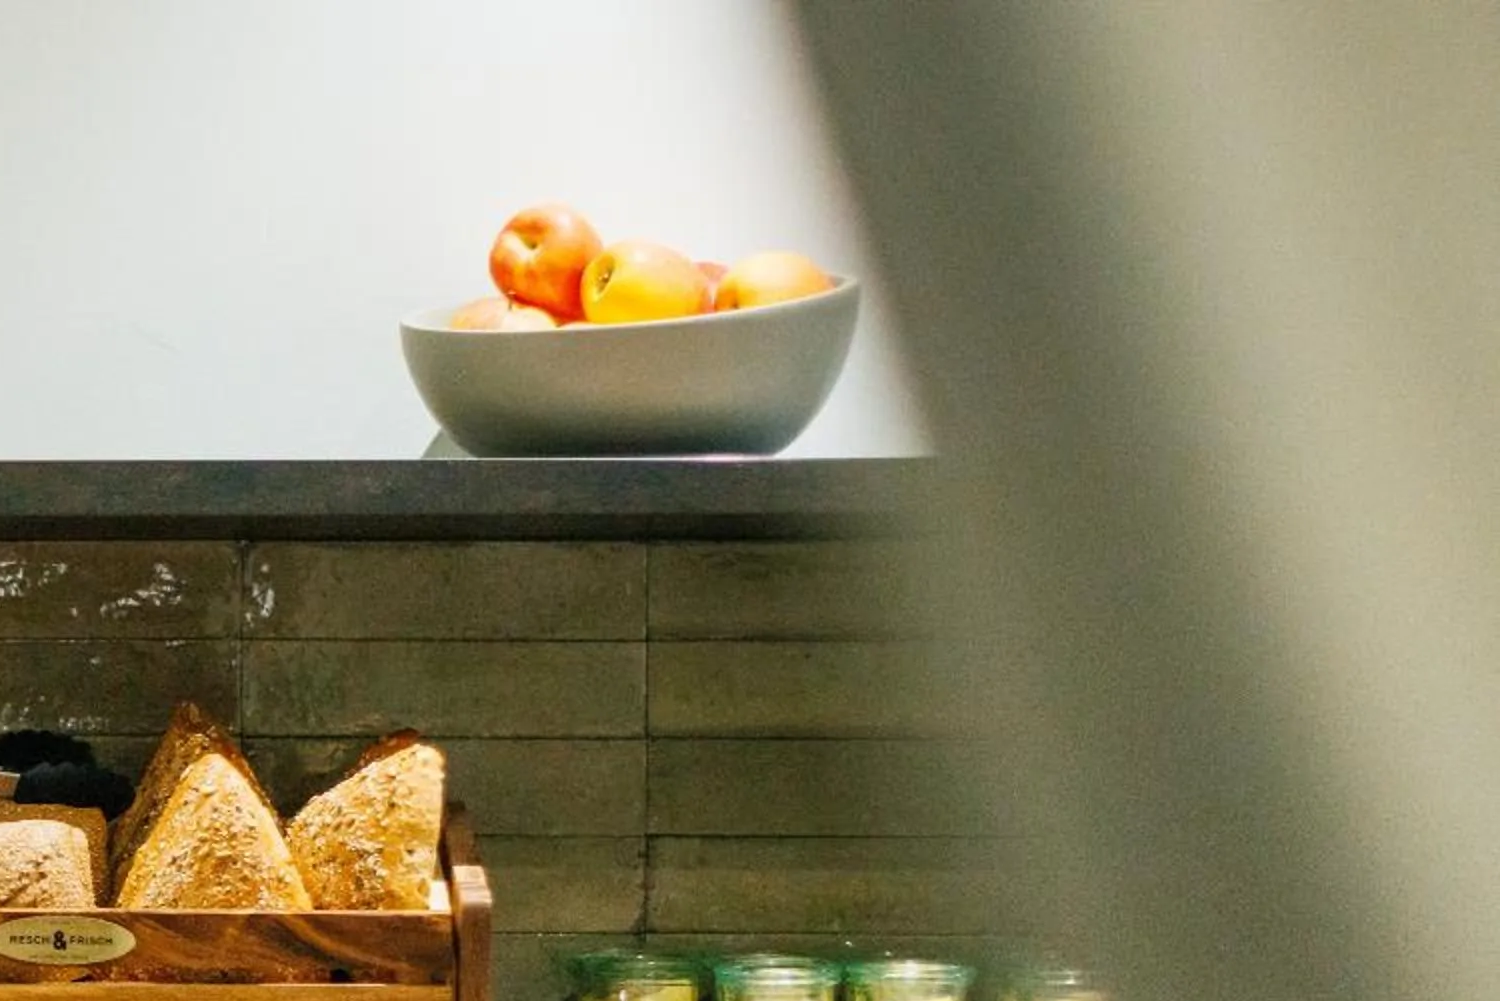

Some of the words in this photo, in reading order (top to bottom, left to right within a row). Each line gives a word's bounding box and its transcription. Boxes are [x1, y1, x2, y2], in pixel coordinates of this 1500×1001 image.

[9, 935, 49, 945] RESCH
[53, 930, 67, 950] &
[70, 935, 113, 945] FRISCH
